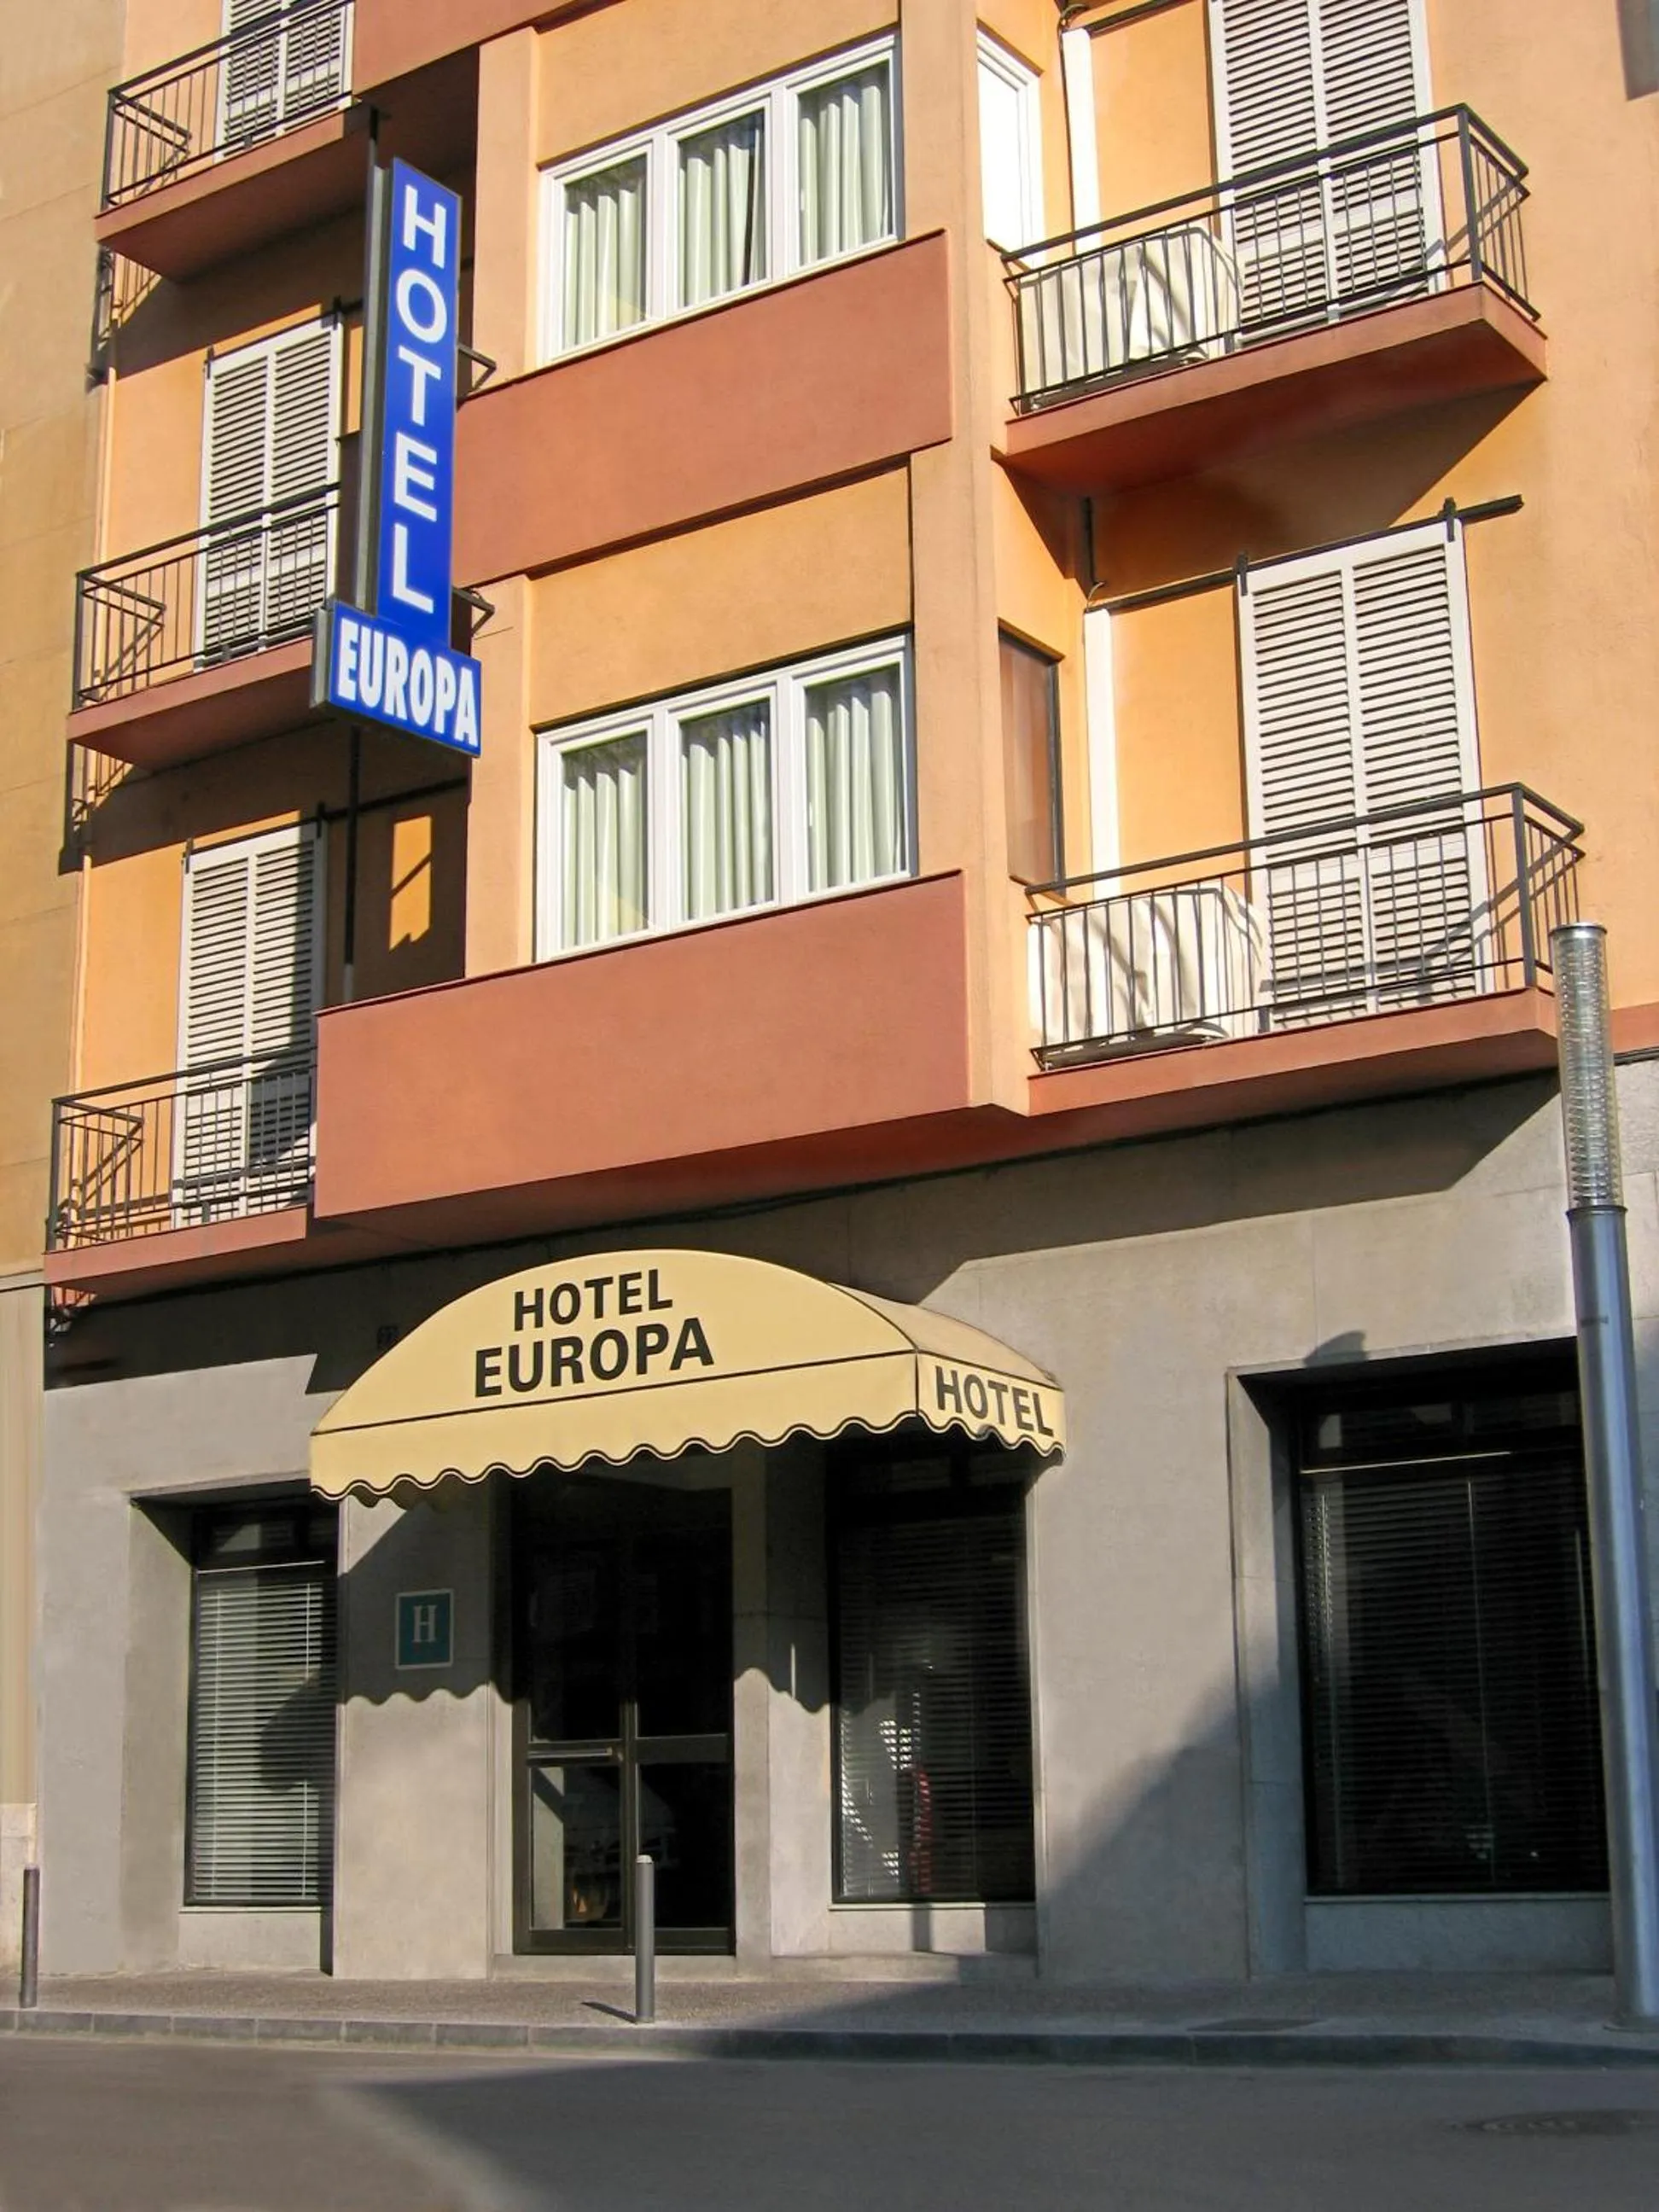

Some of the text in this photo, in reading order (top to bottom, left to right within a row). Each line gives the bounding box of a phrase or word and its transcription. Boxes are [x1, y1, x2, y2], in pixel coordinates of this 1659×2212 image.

[393, 184, 447, 613] HOTEL
[338, 618, 480, 748] EUROPA
[514, 1269, 672, 1331] HOTEL
[475, 1318, 714, 1398] EUROPA
[935, 1365, 1054, 1437] HOTEL
[412, 1604, 438, 1643] H
